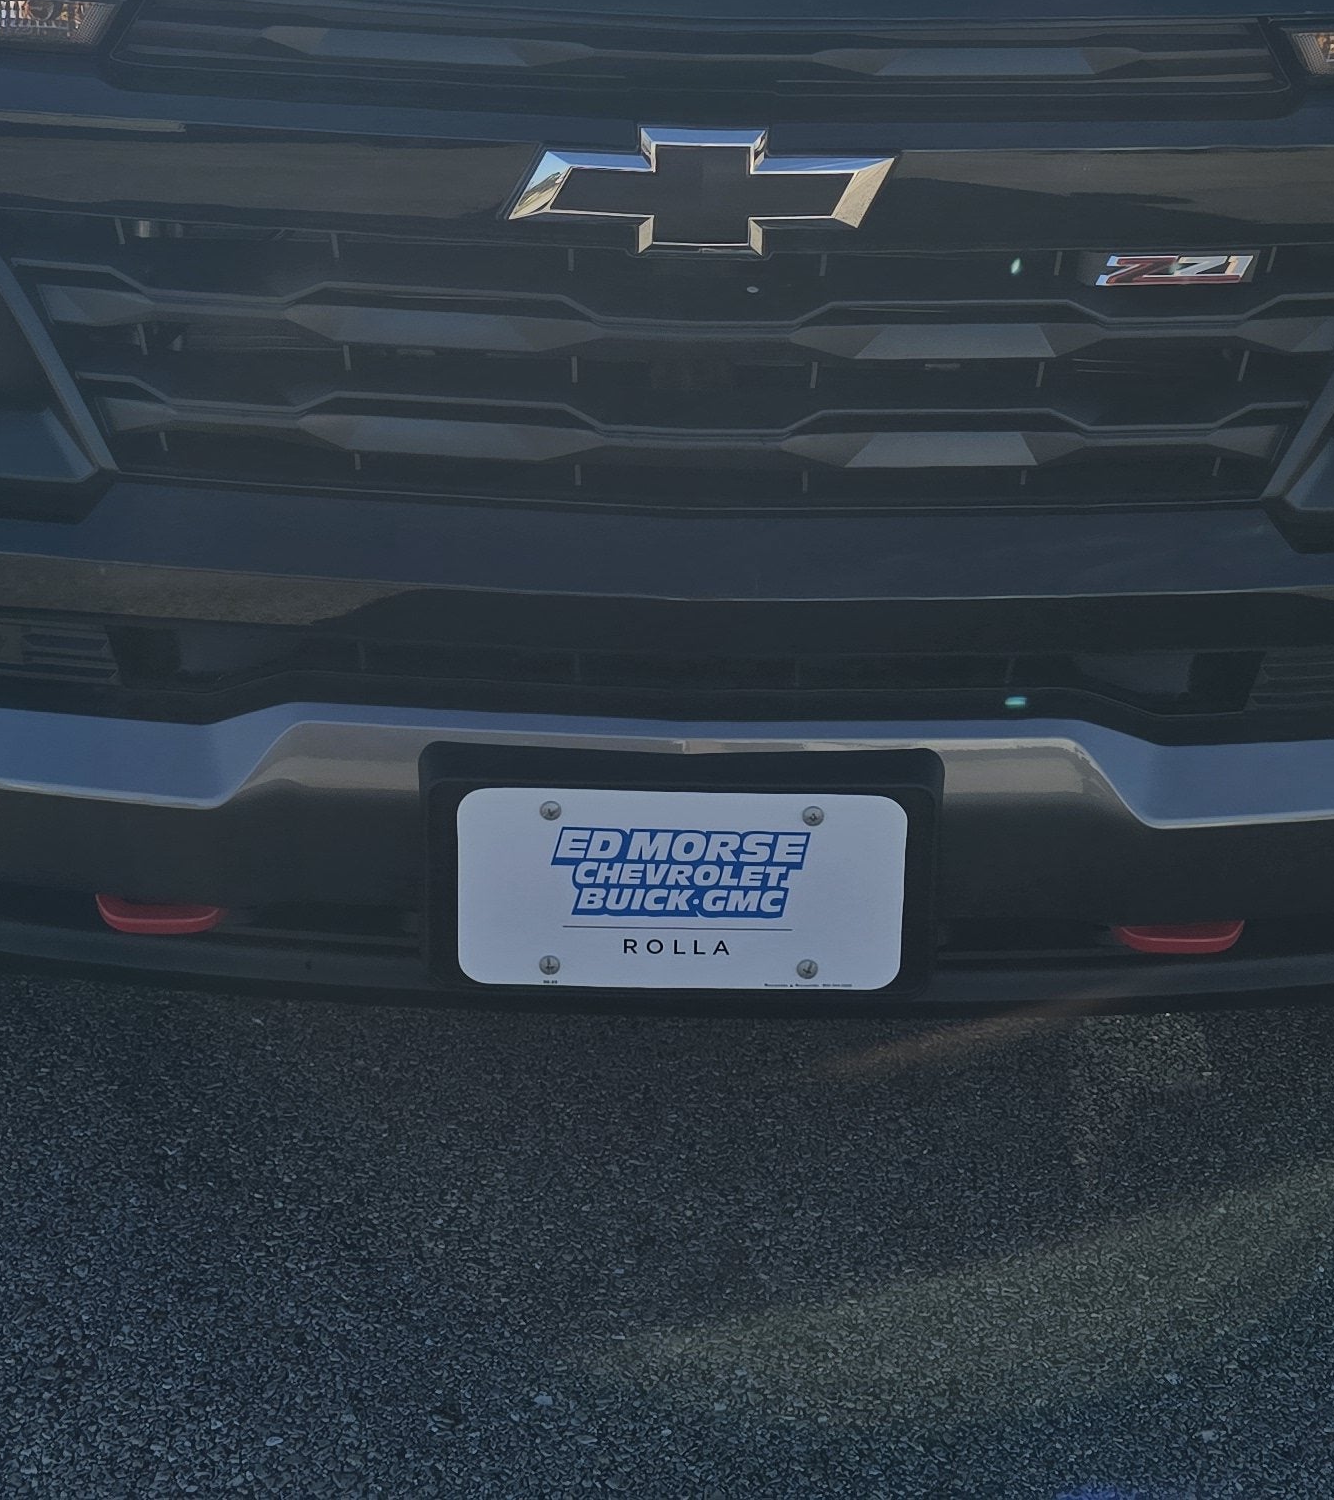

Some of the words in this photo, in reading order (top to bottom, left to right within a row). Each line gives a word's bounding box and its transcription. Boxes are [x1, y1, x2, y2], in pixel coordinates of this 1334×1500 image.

[1095, 255, 1254, 286] Z71
[555, 829, 624, 860] ED
[625, 831, 808, 863] MORSE
[574, 861, 788, 887] CHEVROLET
[623, 938, 730, 956] ROLLA
